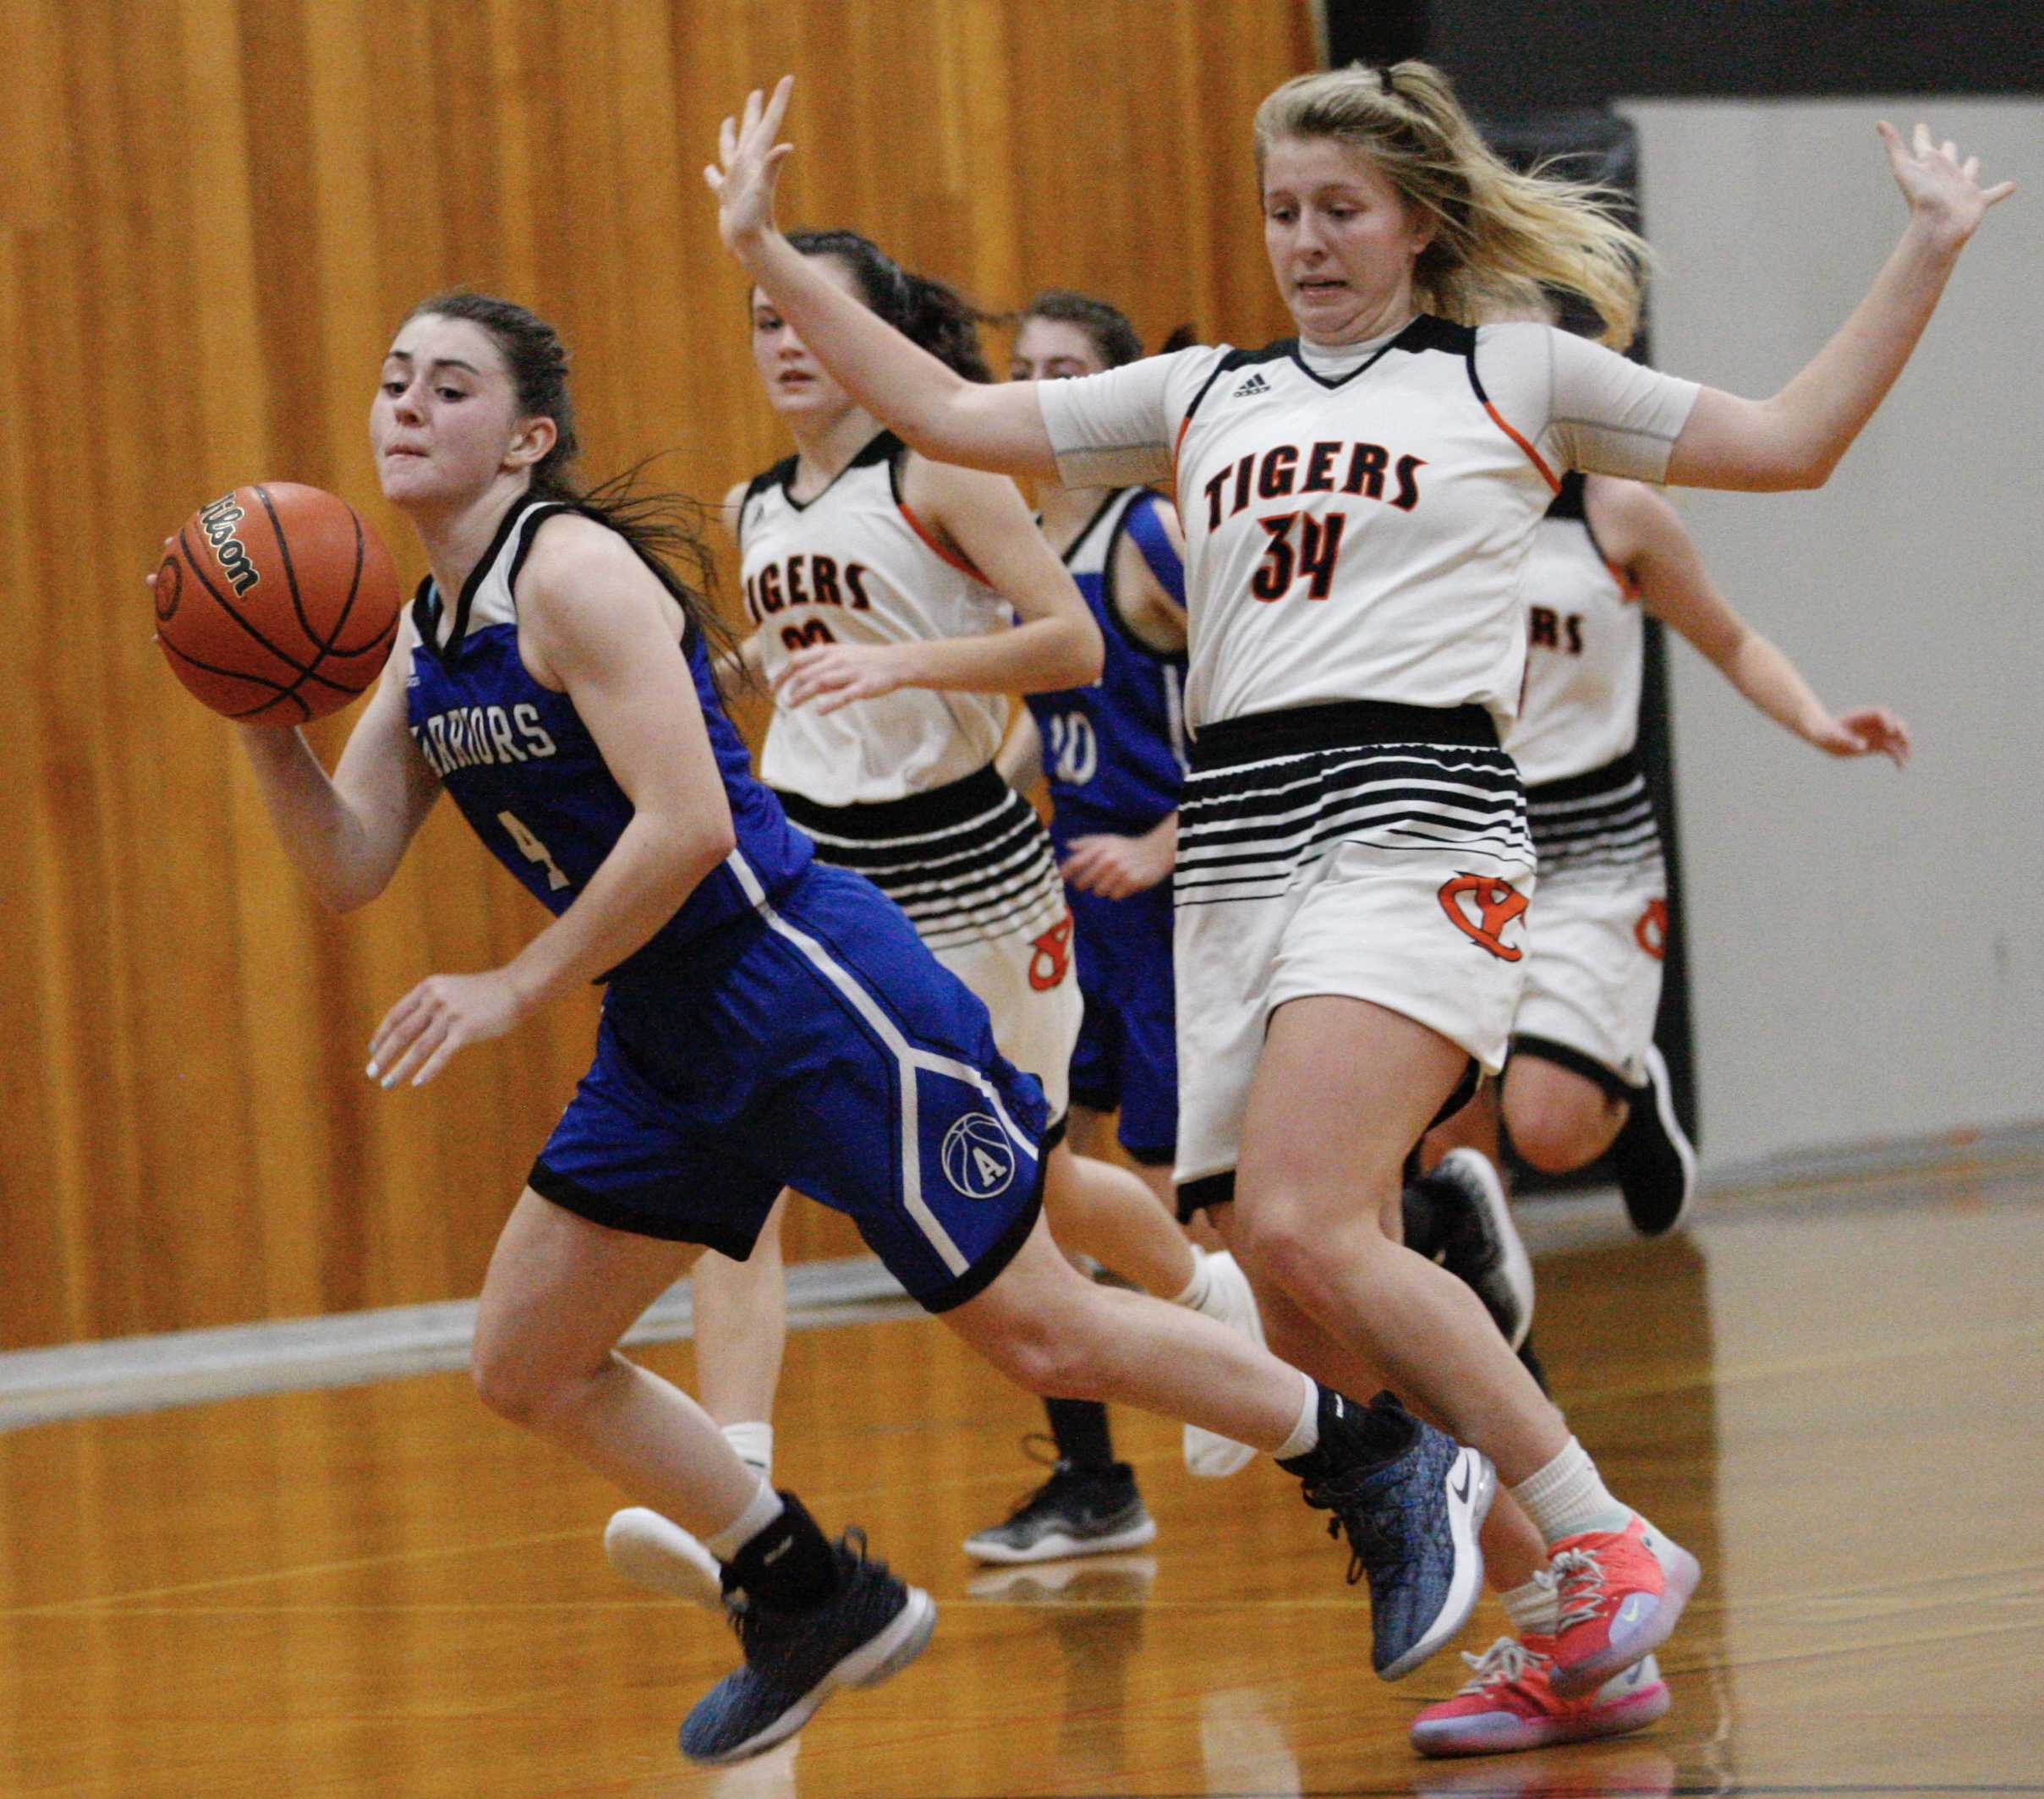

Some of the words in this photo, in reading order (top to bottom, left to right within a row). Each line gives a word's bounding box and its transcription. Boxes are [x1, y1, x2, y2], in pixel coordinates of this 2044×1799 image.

[1204, 441, 1429, 534] TIGERS
[1252, 510, 1346, 602] 34
[497, 809, 572, 891] 4
[973, 1146, 1008, 1187] A
